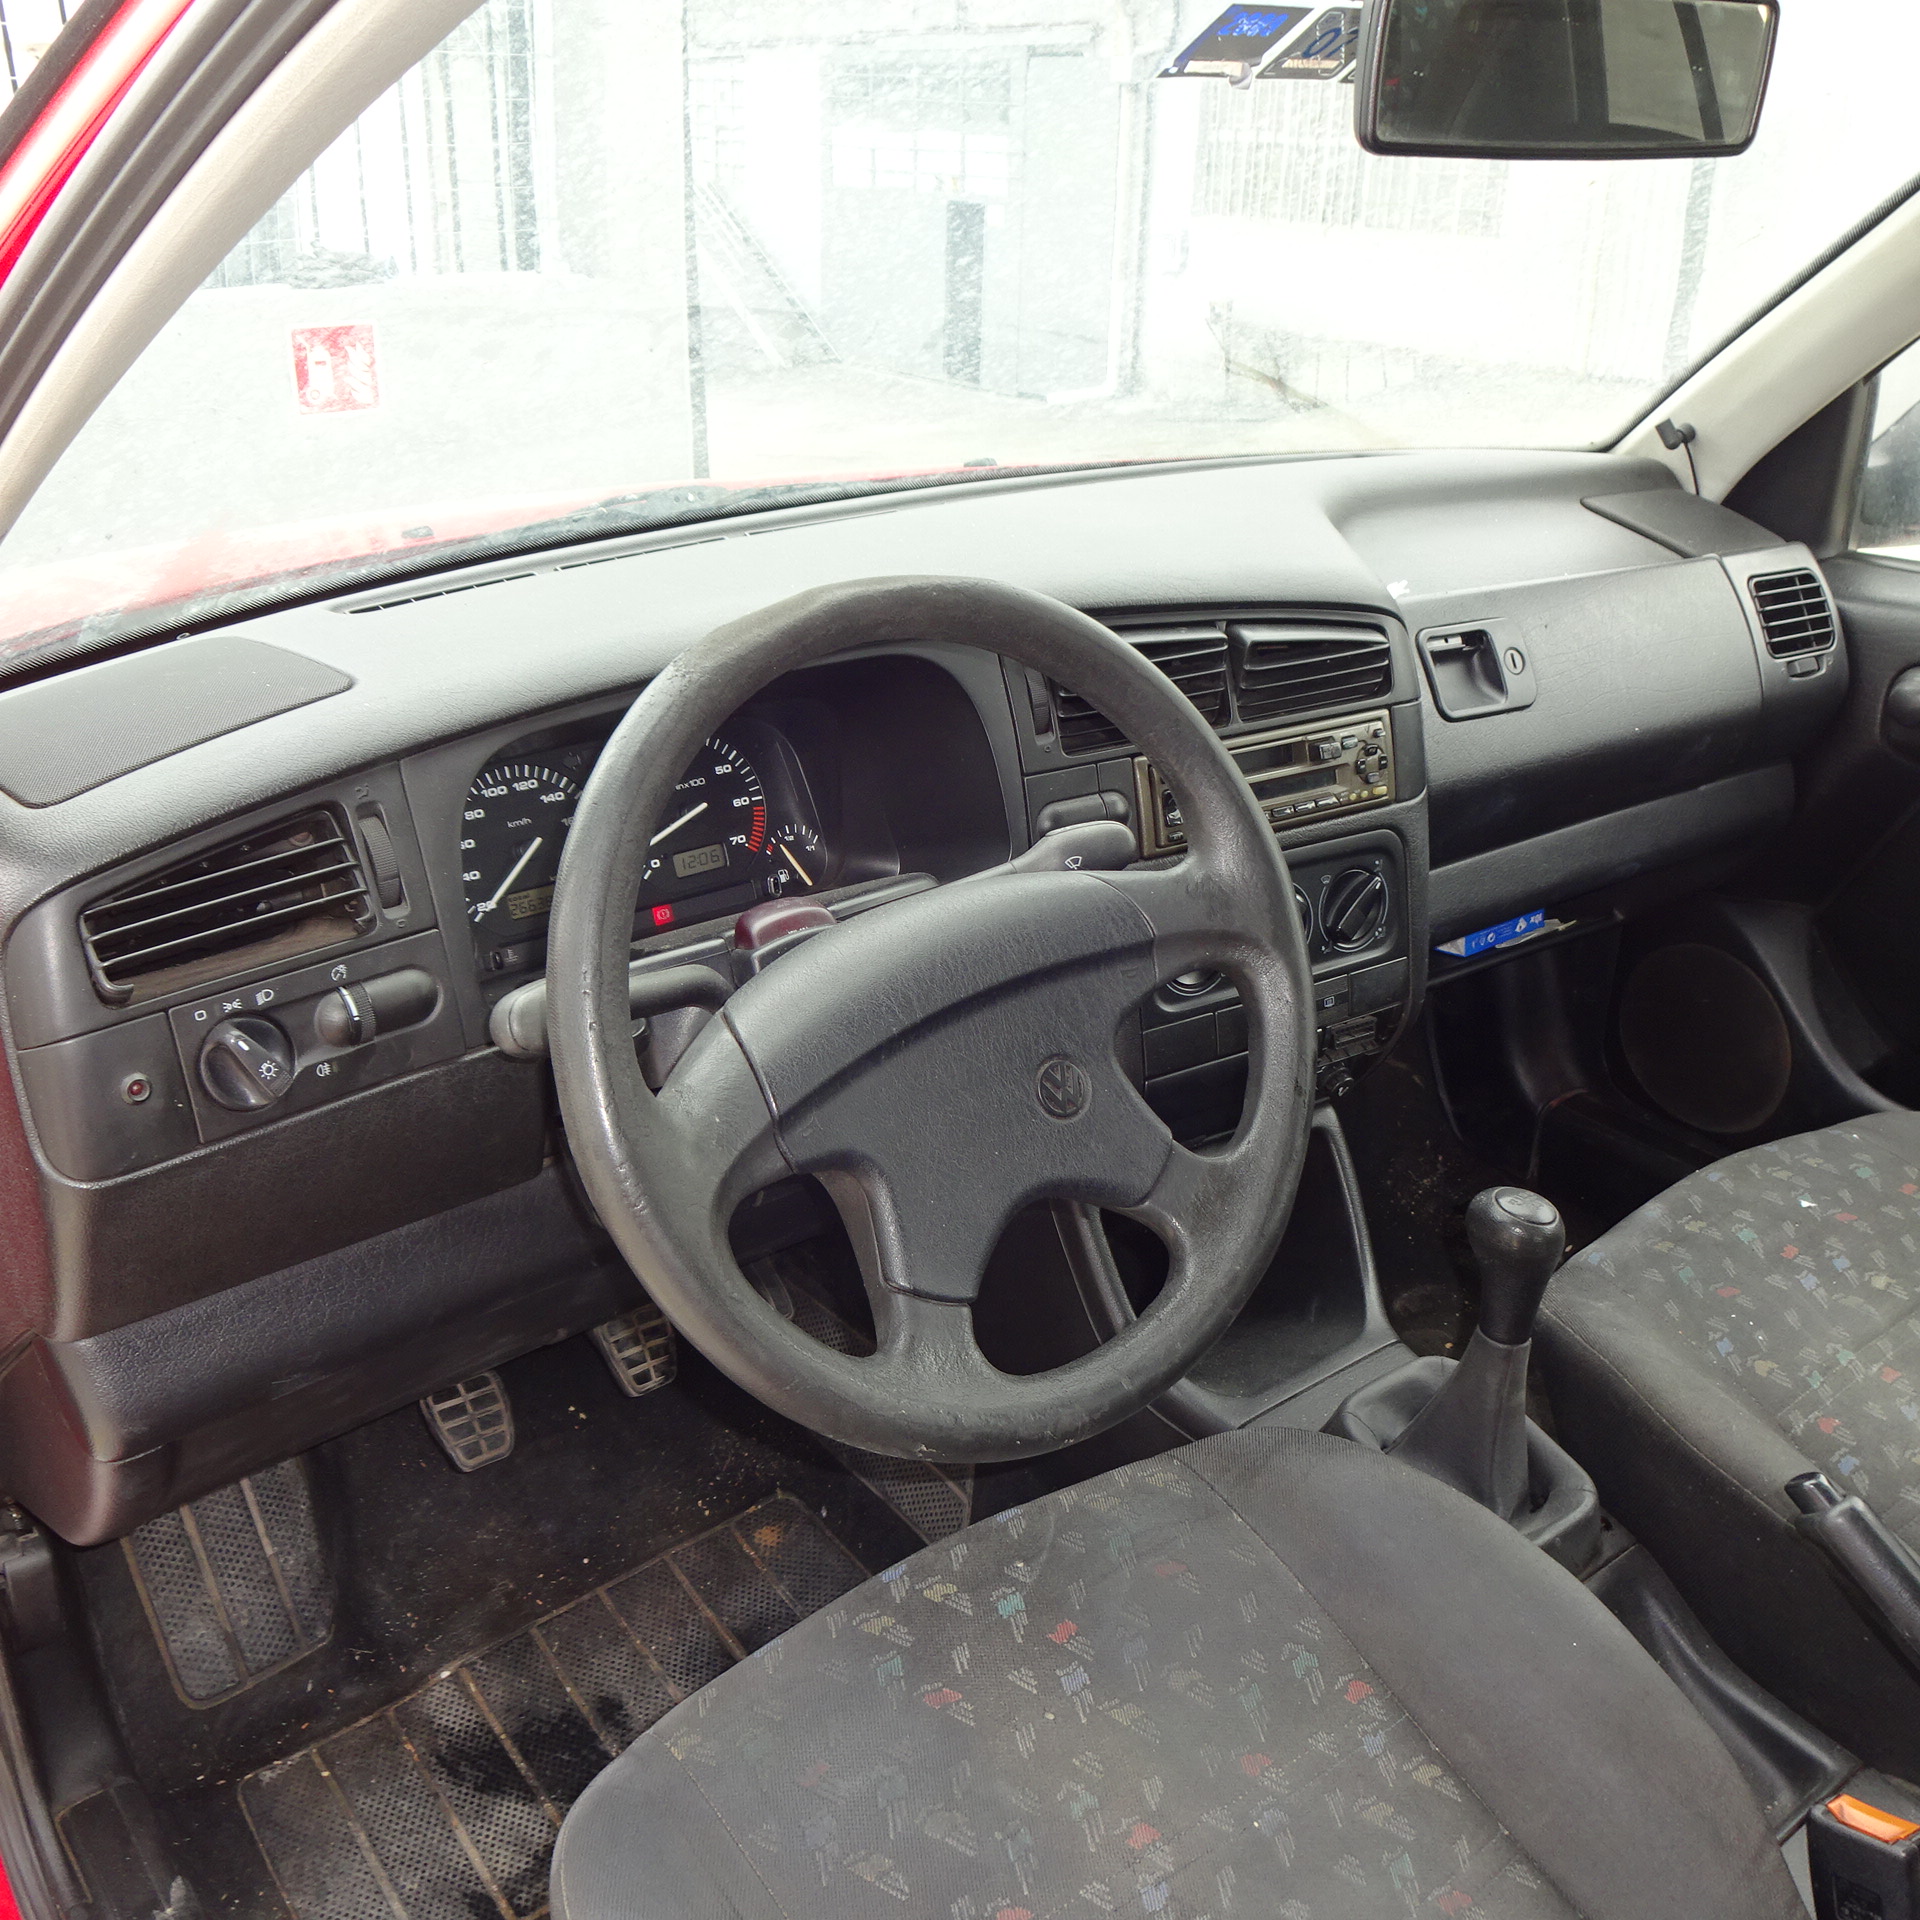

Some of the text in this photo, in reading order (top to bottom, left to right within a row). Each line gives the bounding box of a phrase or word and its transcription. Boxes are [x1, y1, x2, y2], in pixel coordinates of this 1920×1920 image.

[714, 764, 732, 775] 50
[512, 779, 539, 791] 120
[481, 785, 509, 798] 100
[540, 791, 566, 803] 140
[732, 796, 750, 807] 60
[463, 808, 486, 820] 80
[507, 817, 533, 828] km/h
[729, 834, 747, 846] 70
[682, 848, 720, 870] 12:06
